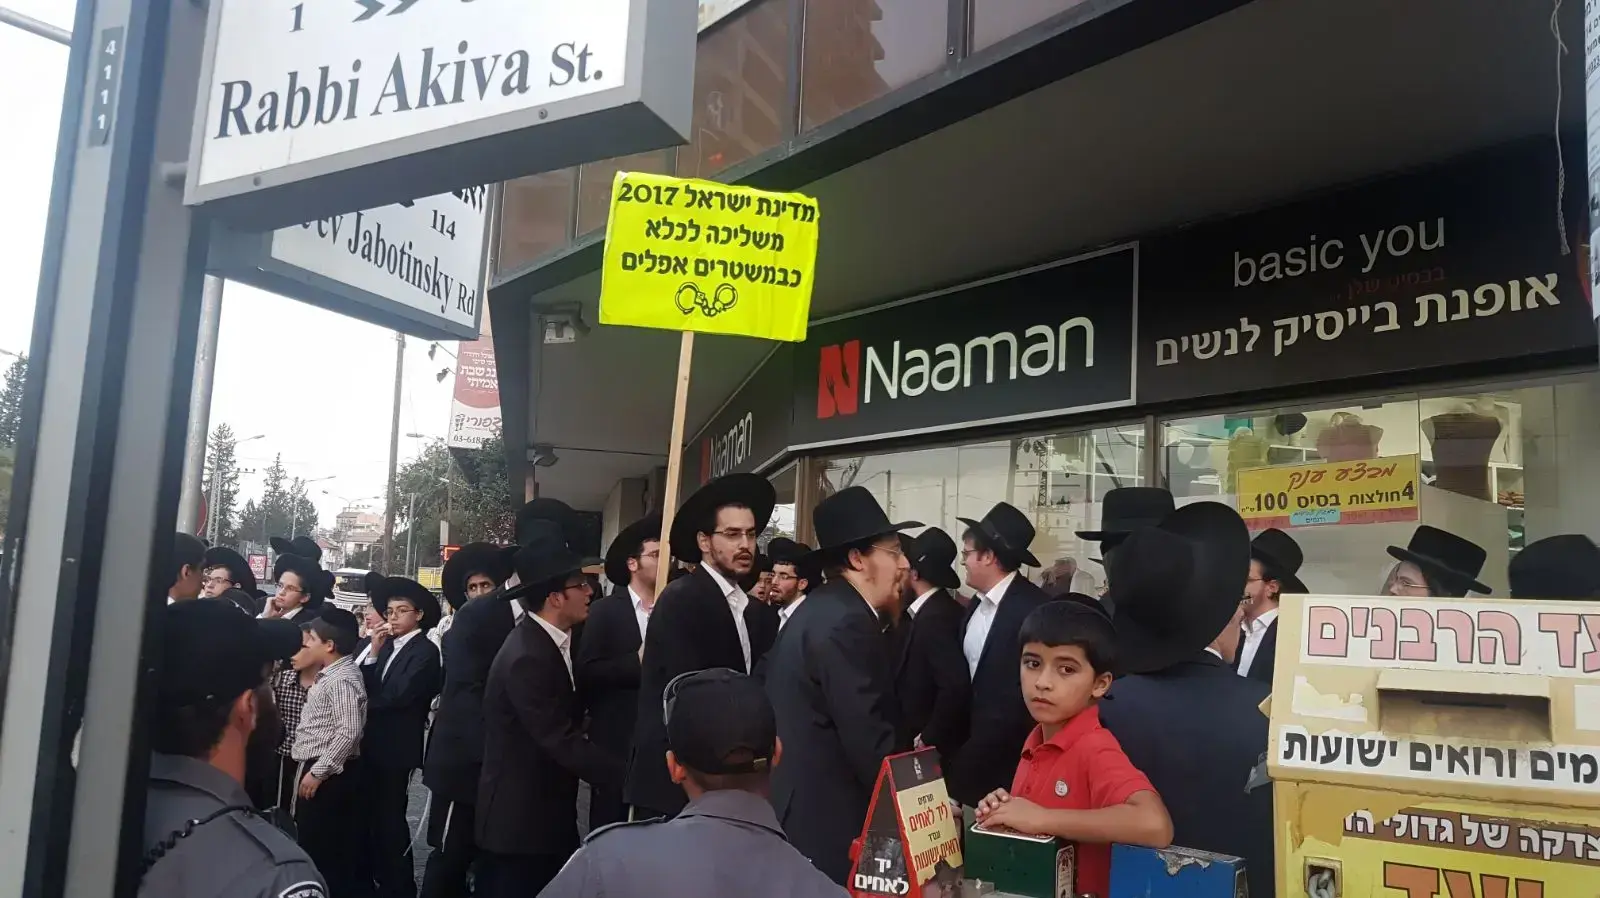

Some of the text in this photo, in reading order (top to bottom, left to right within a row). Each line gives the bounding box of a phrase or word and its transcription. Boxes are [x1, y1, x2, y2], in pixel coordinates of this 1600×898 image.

[213, 40, 603, 140] Rabbi Akiva St.
[617, 183, 815, 223] מדינת ישראל 2017
[431, 209, 456, 241] 114
[645, 216, 784, 252] משליכה לכלא
[347, 211, 454, 314] Jabotinsky
[456, 282, 475, 316] Rd
[621, 249, 802, 288] כבמשטרים אפלים
[1233, 216, 1446, 287] basic you
[1156, 272, 1561, 366] אופנת בייסיק לנשים
[864, 316, 1095, 404] Naaman
[709, 411, 753, 480] Naaman
[1287, 462, 1397, 492] מבצע ענק
[1401, 480, 1415, 501] 4
[1254, 491, 1288, 512] 100
[1296, 493, 1341, 508] בסיס
[1347, 489, 1400, 506] חולצות
[1308, 605, 1522, 666] הרבנים
[1283, 732, 1398, 767] ישועות
[1409, 741, 1516, 778] ורואים
[908, 802, 948, 832] ליד לאחים
[1383, 812, 1455, 844] גדולי
[1461, 813, 1510, 849] של
[874, 857, 891, 873] יד
[854, 873, 909, 895] לאחים
